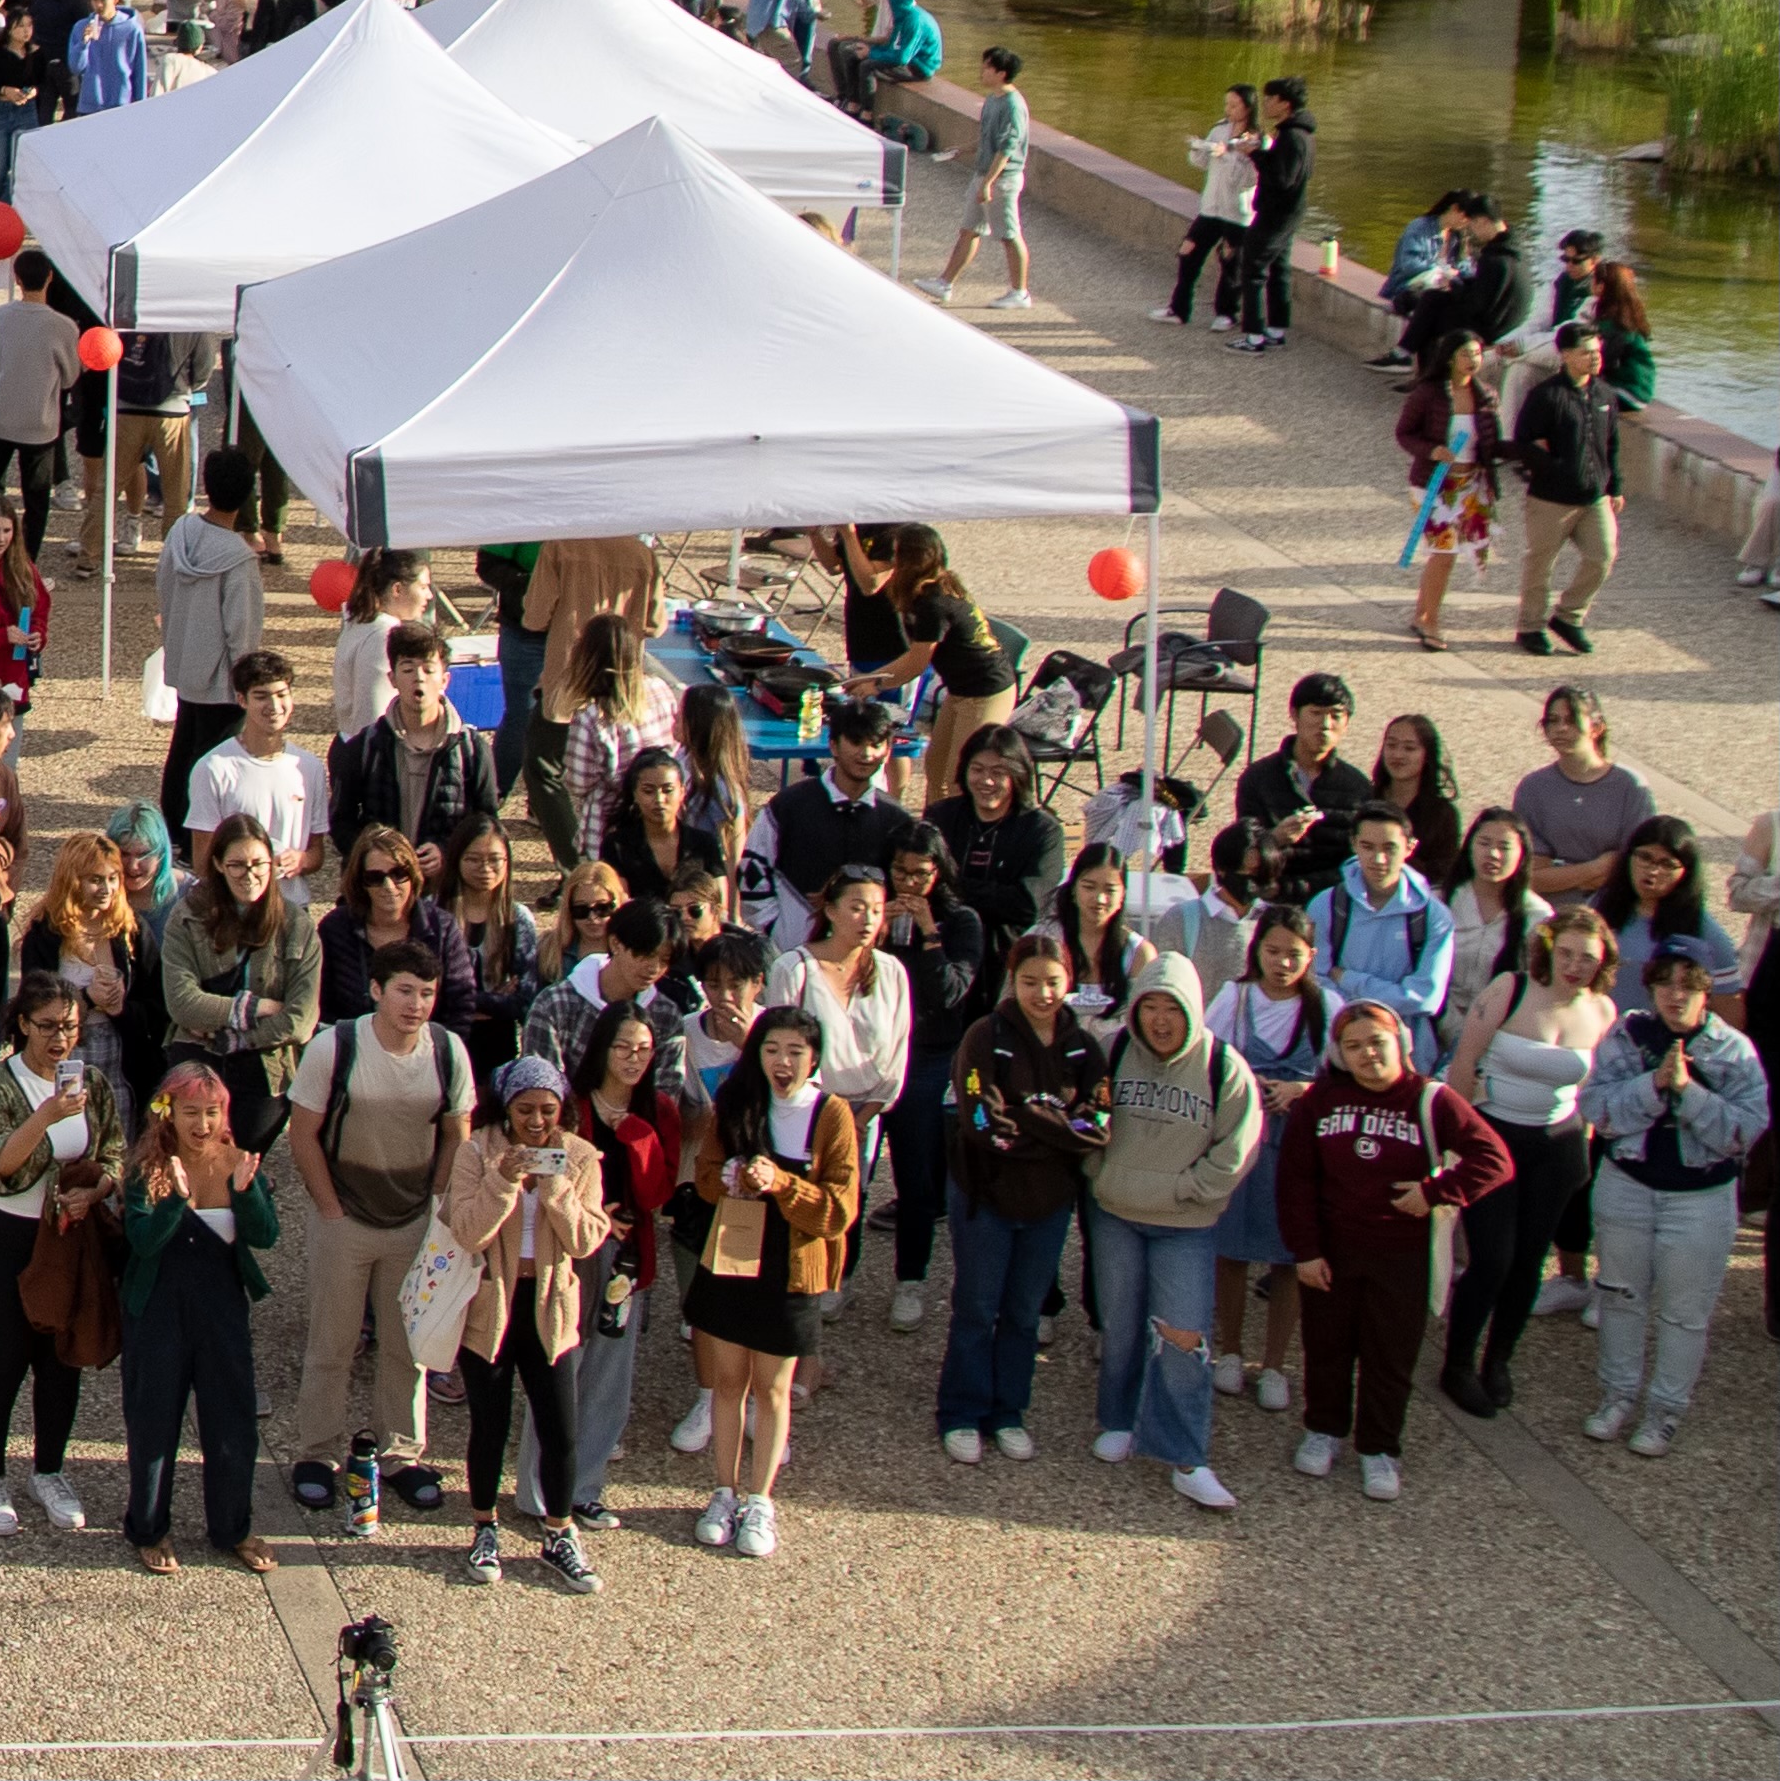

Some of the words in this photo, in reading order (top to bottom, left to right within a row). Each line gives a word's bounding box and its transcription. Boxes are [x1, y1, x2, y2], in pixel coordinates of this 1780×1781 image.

[1114, 1080, 1212, 1129] ERMONT
[1316, 1113, 1357, 1137] SAN
[1361, 1114, 1421, 1146] DIEGO
